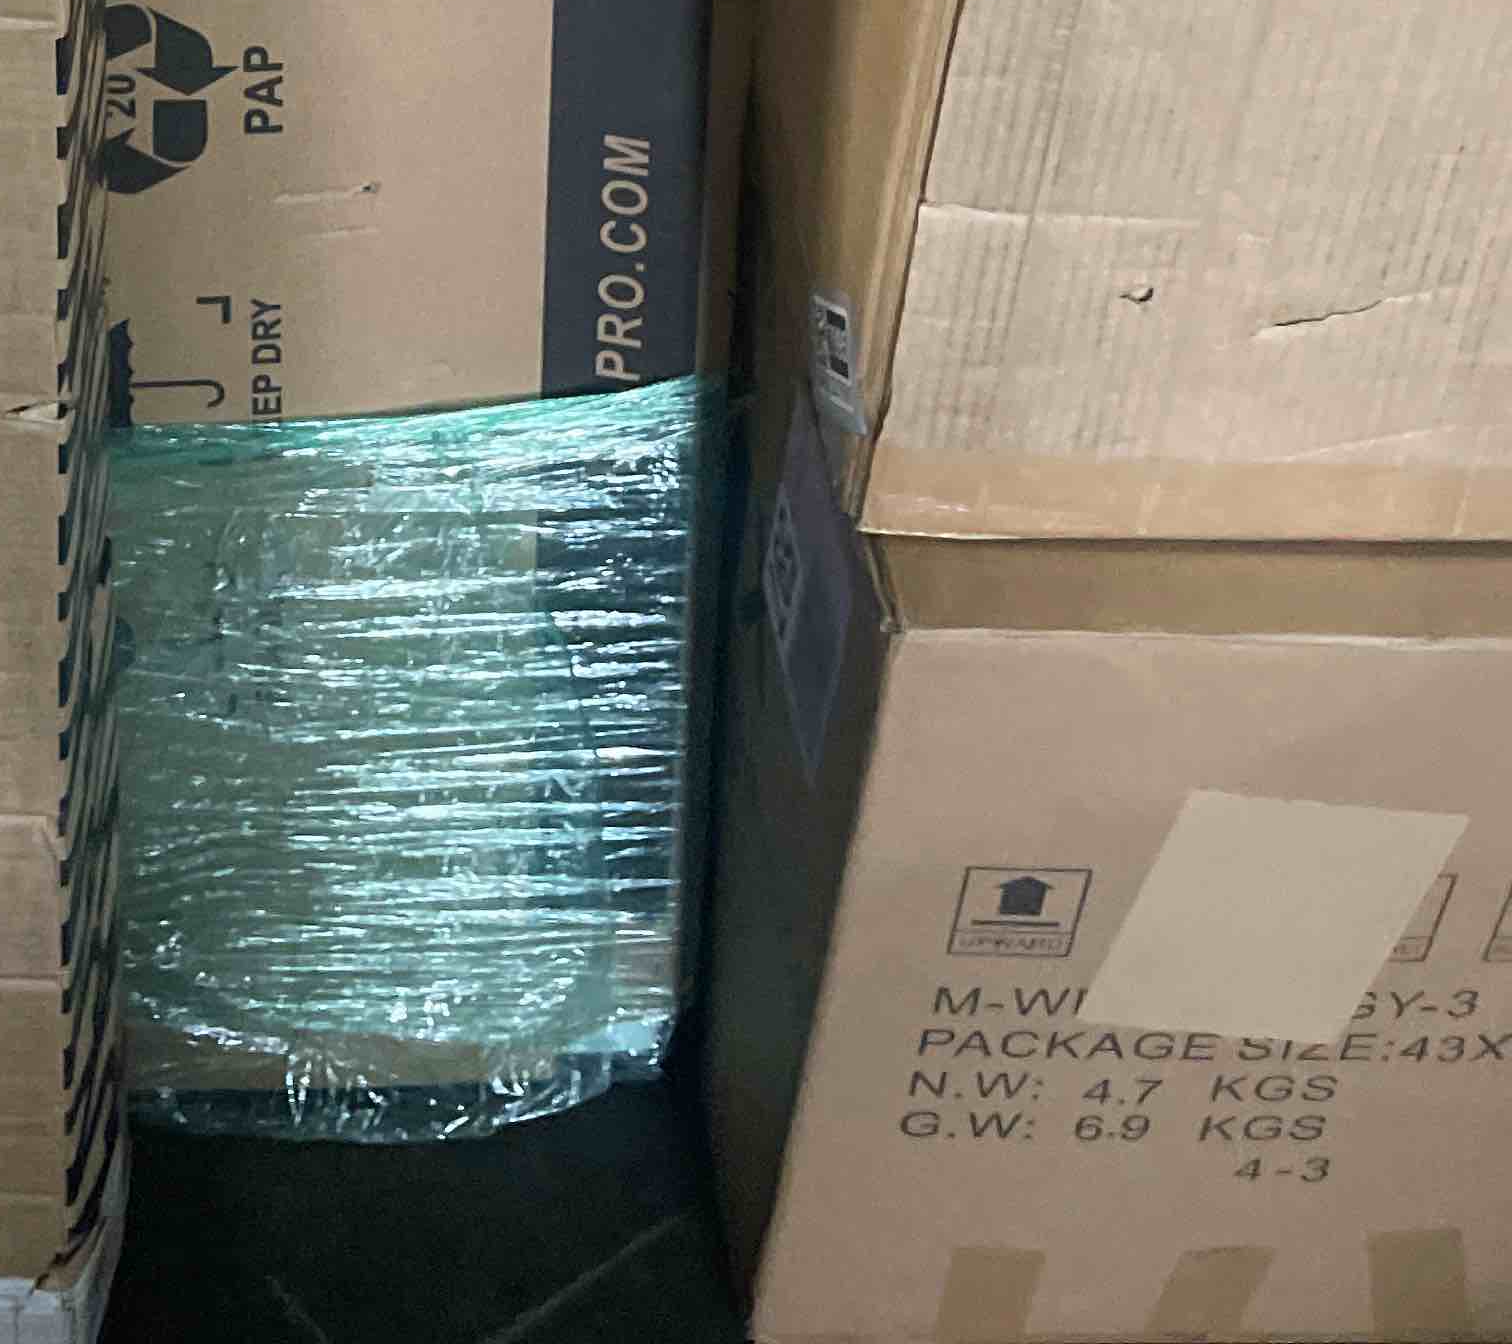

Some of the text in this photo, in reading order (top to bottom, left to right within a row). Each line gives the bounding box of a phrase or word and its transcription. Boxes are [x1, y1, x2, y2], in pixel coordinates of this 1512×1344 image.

[243, 46, 284, 135] PAP
[595, 134, 651, 382] PRO.COM
[250, 299, 283, 422] EP DRY
[917, 1028, 1217, 1063] PACKAGE
[908, 1071, 1340, 1106] N.W: 4.7 KGS
[899, 1111, 1328, 1143] G.W: 6.9 KGS
[1233, 1157, 1331, 1182] 4-3
